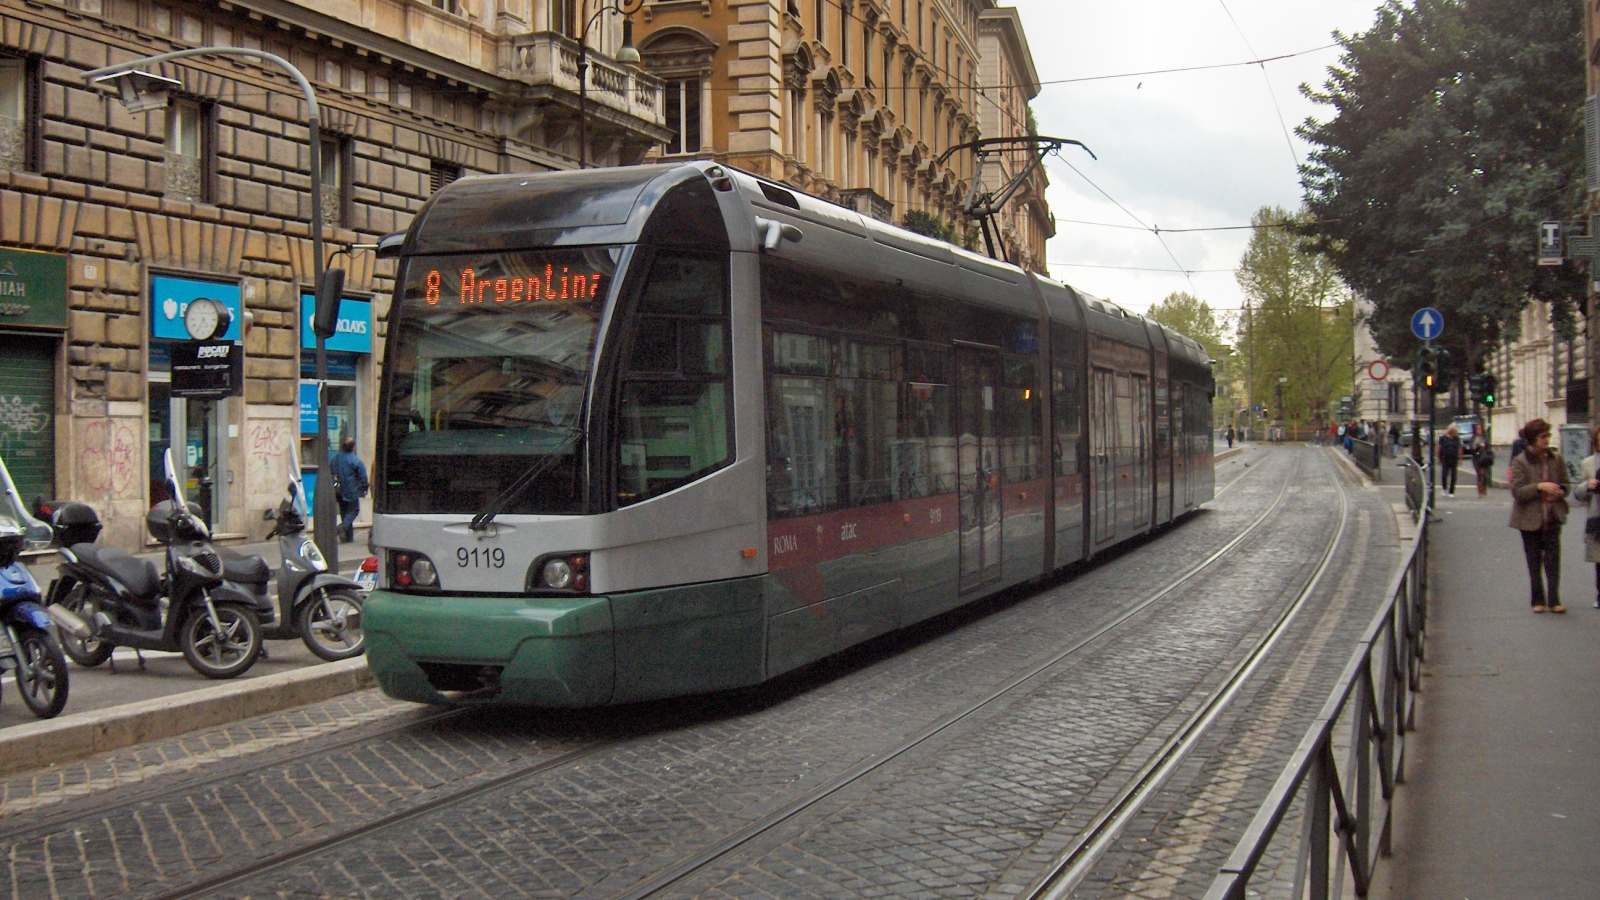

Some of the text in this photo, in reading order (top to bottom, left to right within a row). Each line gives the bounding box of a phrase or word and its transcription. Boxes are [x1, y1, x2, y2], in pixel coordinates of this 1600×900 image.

[427, 270, 440, 305] 8
[335, 318, 366, 335] RCLAYS
[198, 345, 230, 354] DUCATI
[774, 522, 857, 555] ROMA atac
[456, 547, 506, 568] 9119
